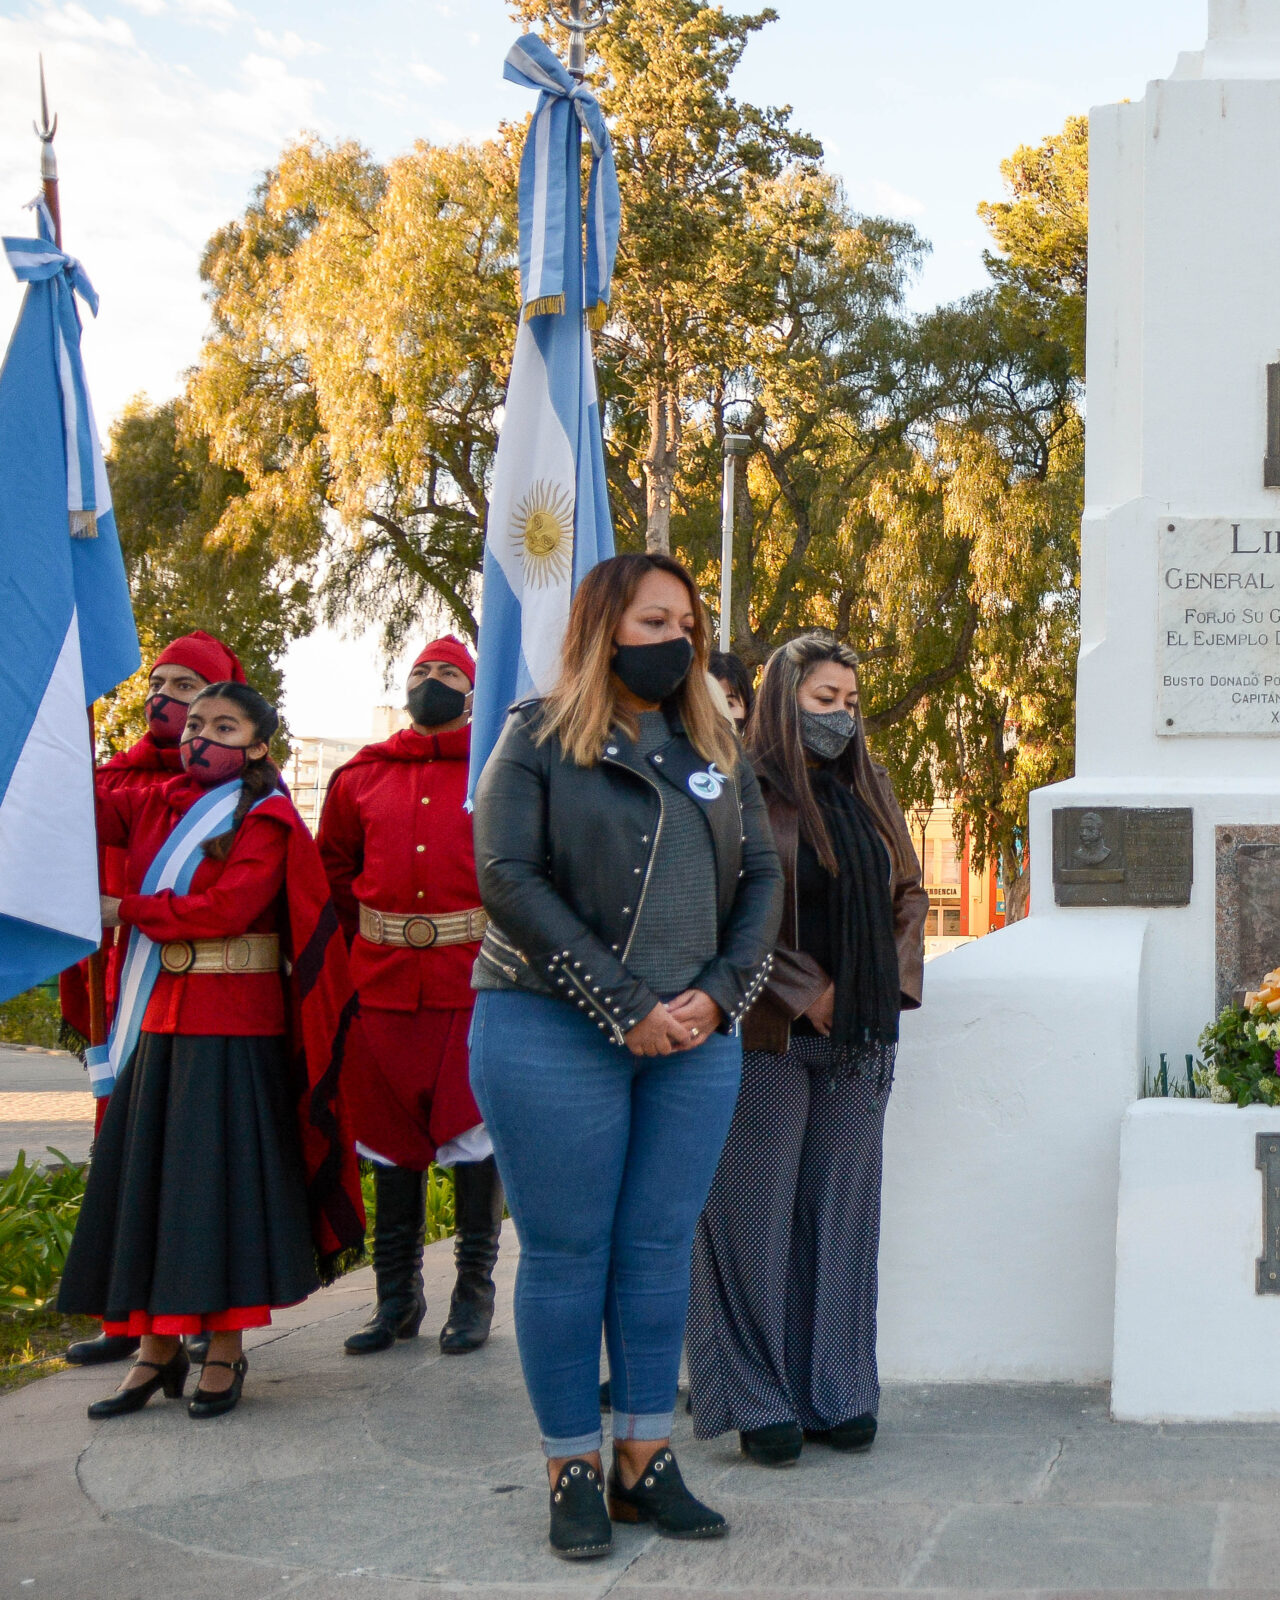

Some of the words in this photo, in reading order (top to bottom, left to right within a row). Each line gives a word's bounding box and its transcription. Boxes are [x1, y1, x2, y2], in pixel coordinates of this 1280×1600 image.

[1164, 567, 1275, 590] GENERAL
[1241, 607, 1265, 624] SU
[1166, 629, 1189, 646] EL
[1193, 629, 1269, 646] EJEMPLO
[1163, 674, 1204, 687] BUSTO
